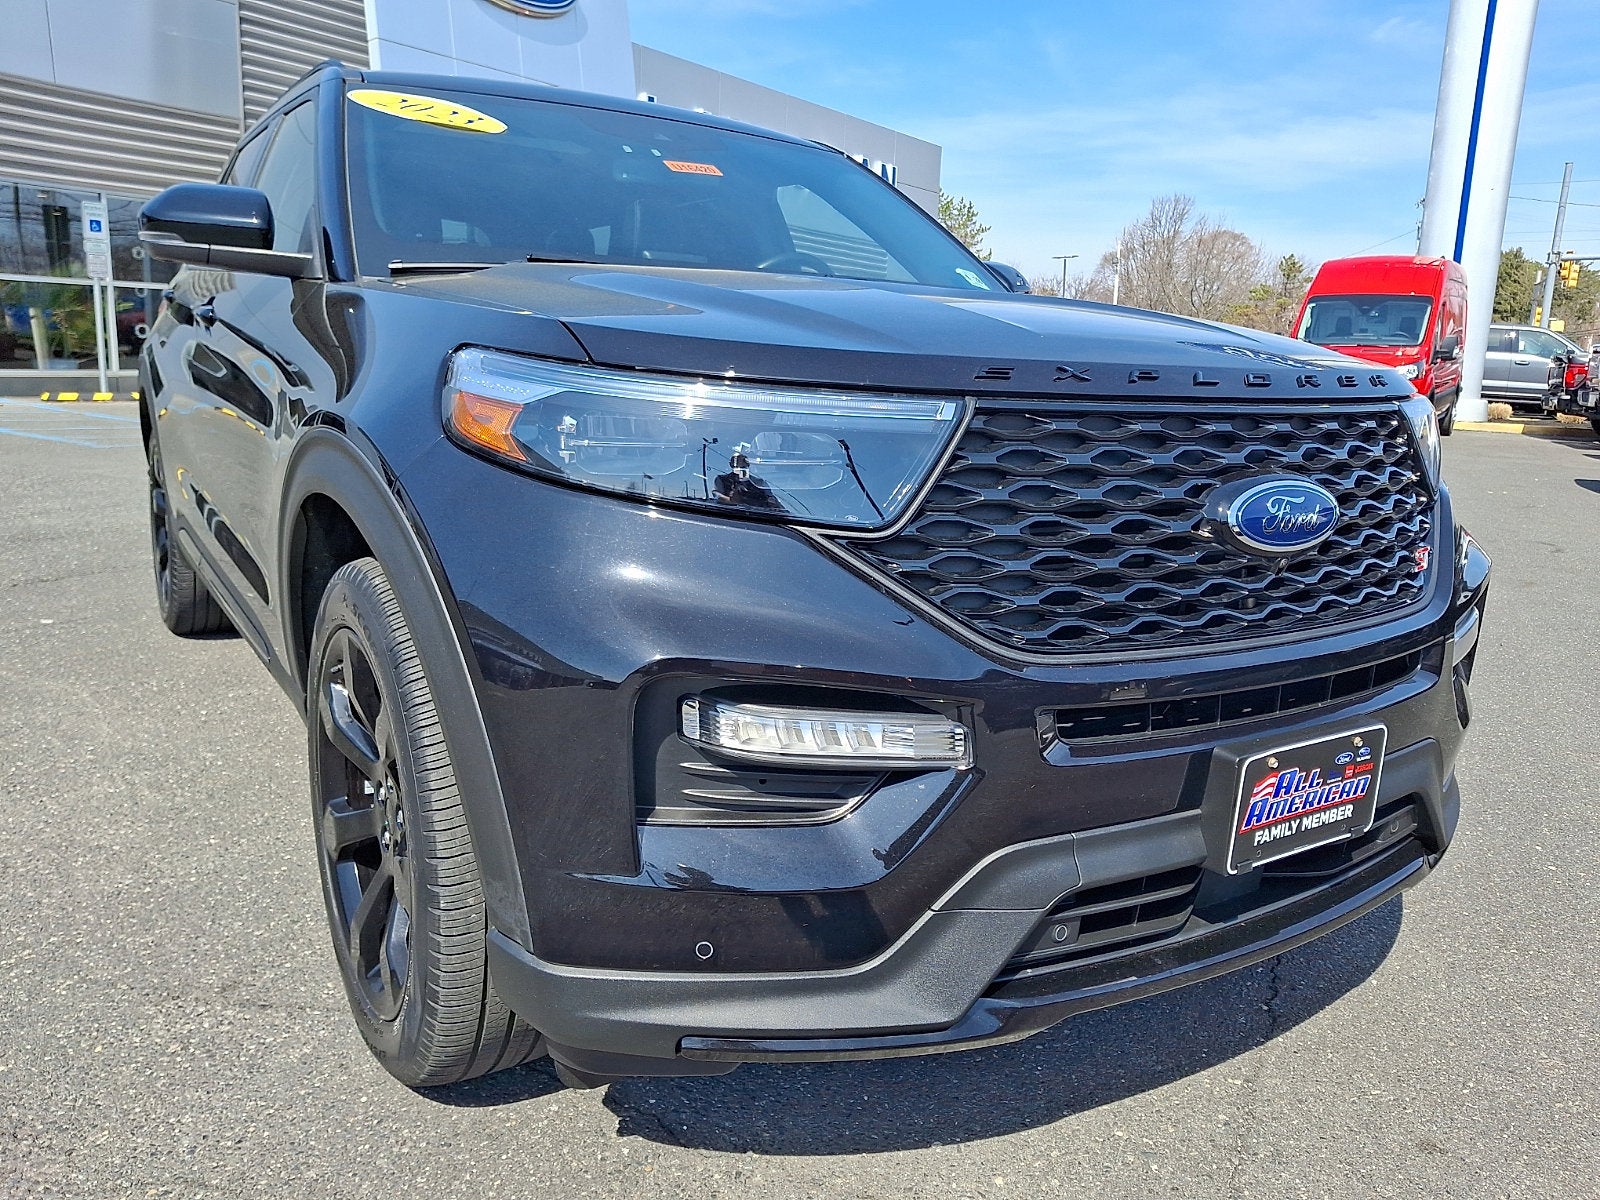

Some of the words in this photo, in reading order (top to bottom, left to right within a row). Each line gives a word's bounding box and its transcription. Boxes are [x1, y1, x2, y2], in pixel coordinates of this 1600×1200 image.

[973, 365, 1390, 388] EXPLORER
[1262, 495, 1320, 534] Ford
[1336, 753, 1353, 764] Ford
[1243, 775, 1371, 830] AMERICAN
[1254, 820, 1301, 846] FAMILY
[1301, 804, 1354, 832] MEMBER
